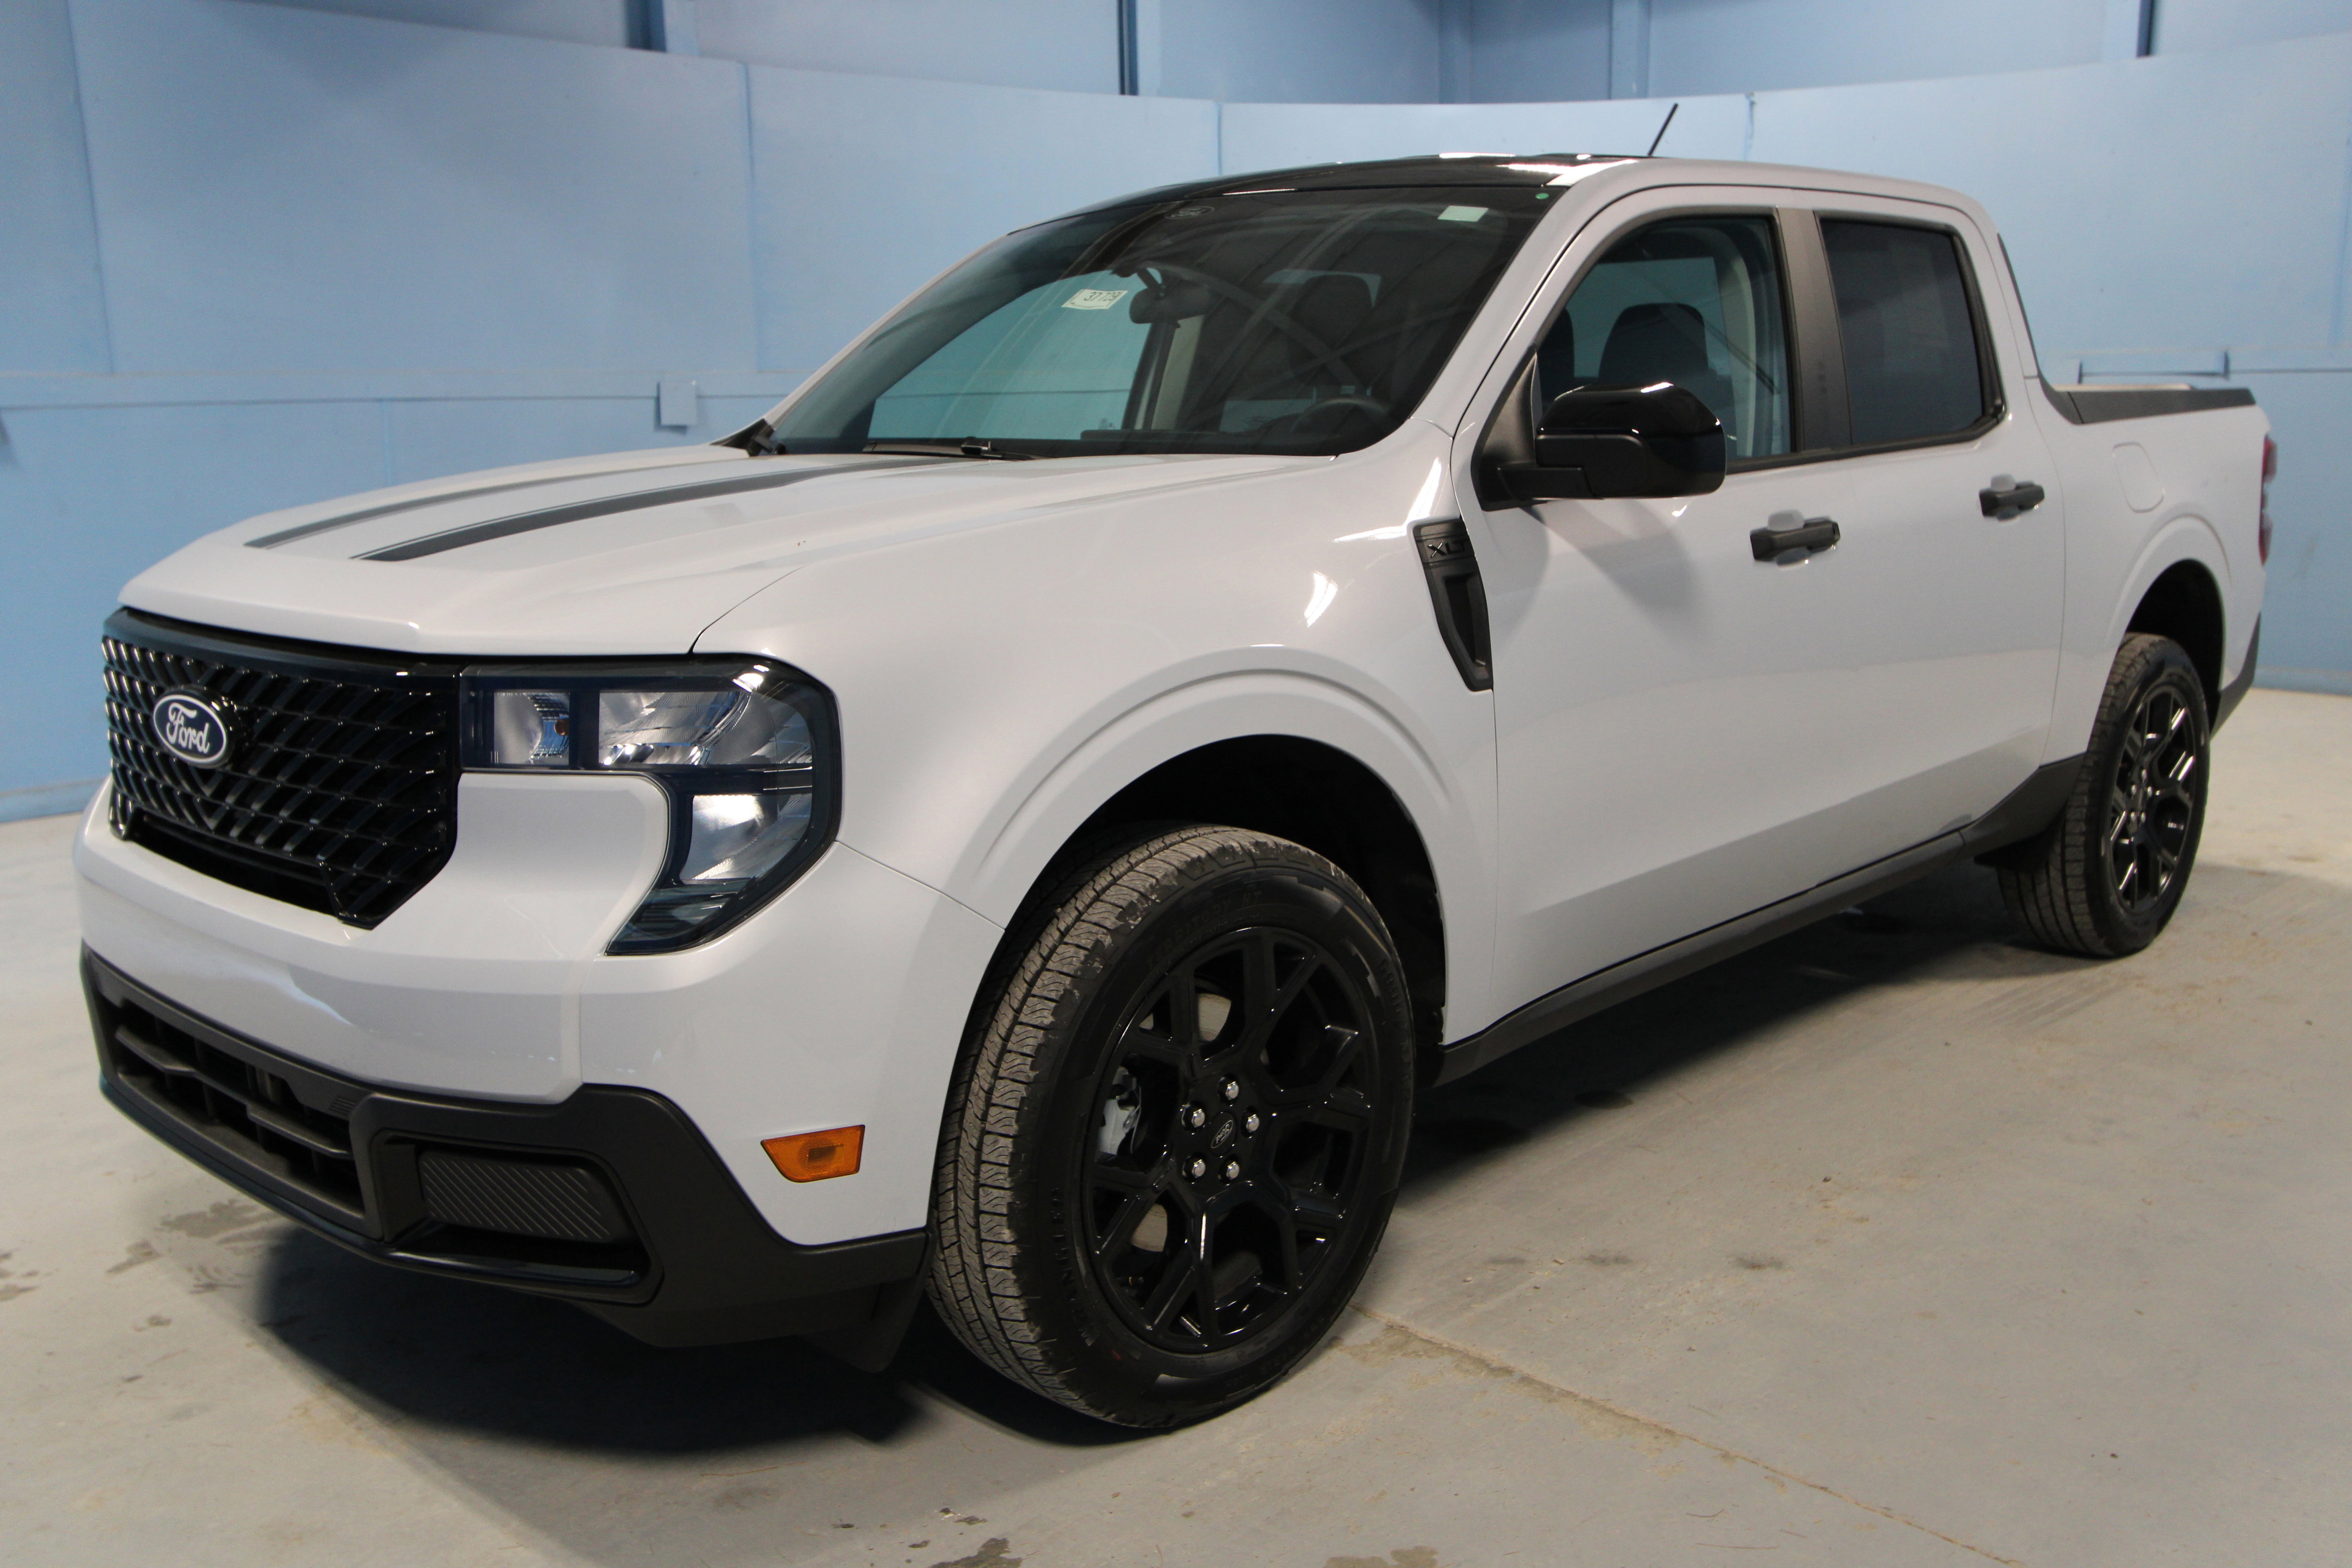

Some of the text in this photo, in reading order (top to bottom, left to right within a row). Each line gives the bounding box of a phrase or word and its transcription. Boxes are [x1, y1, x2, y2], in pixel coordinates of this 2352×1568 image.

[1427, 541, 1466, 558] XLT
[167, 703, 210, 754] Ford
[1215, 1123, 1230, 1144] Ford
